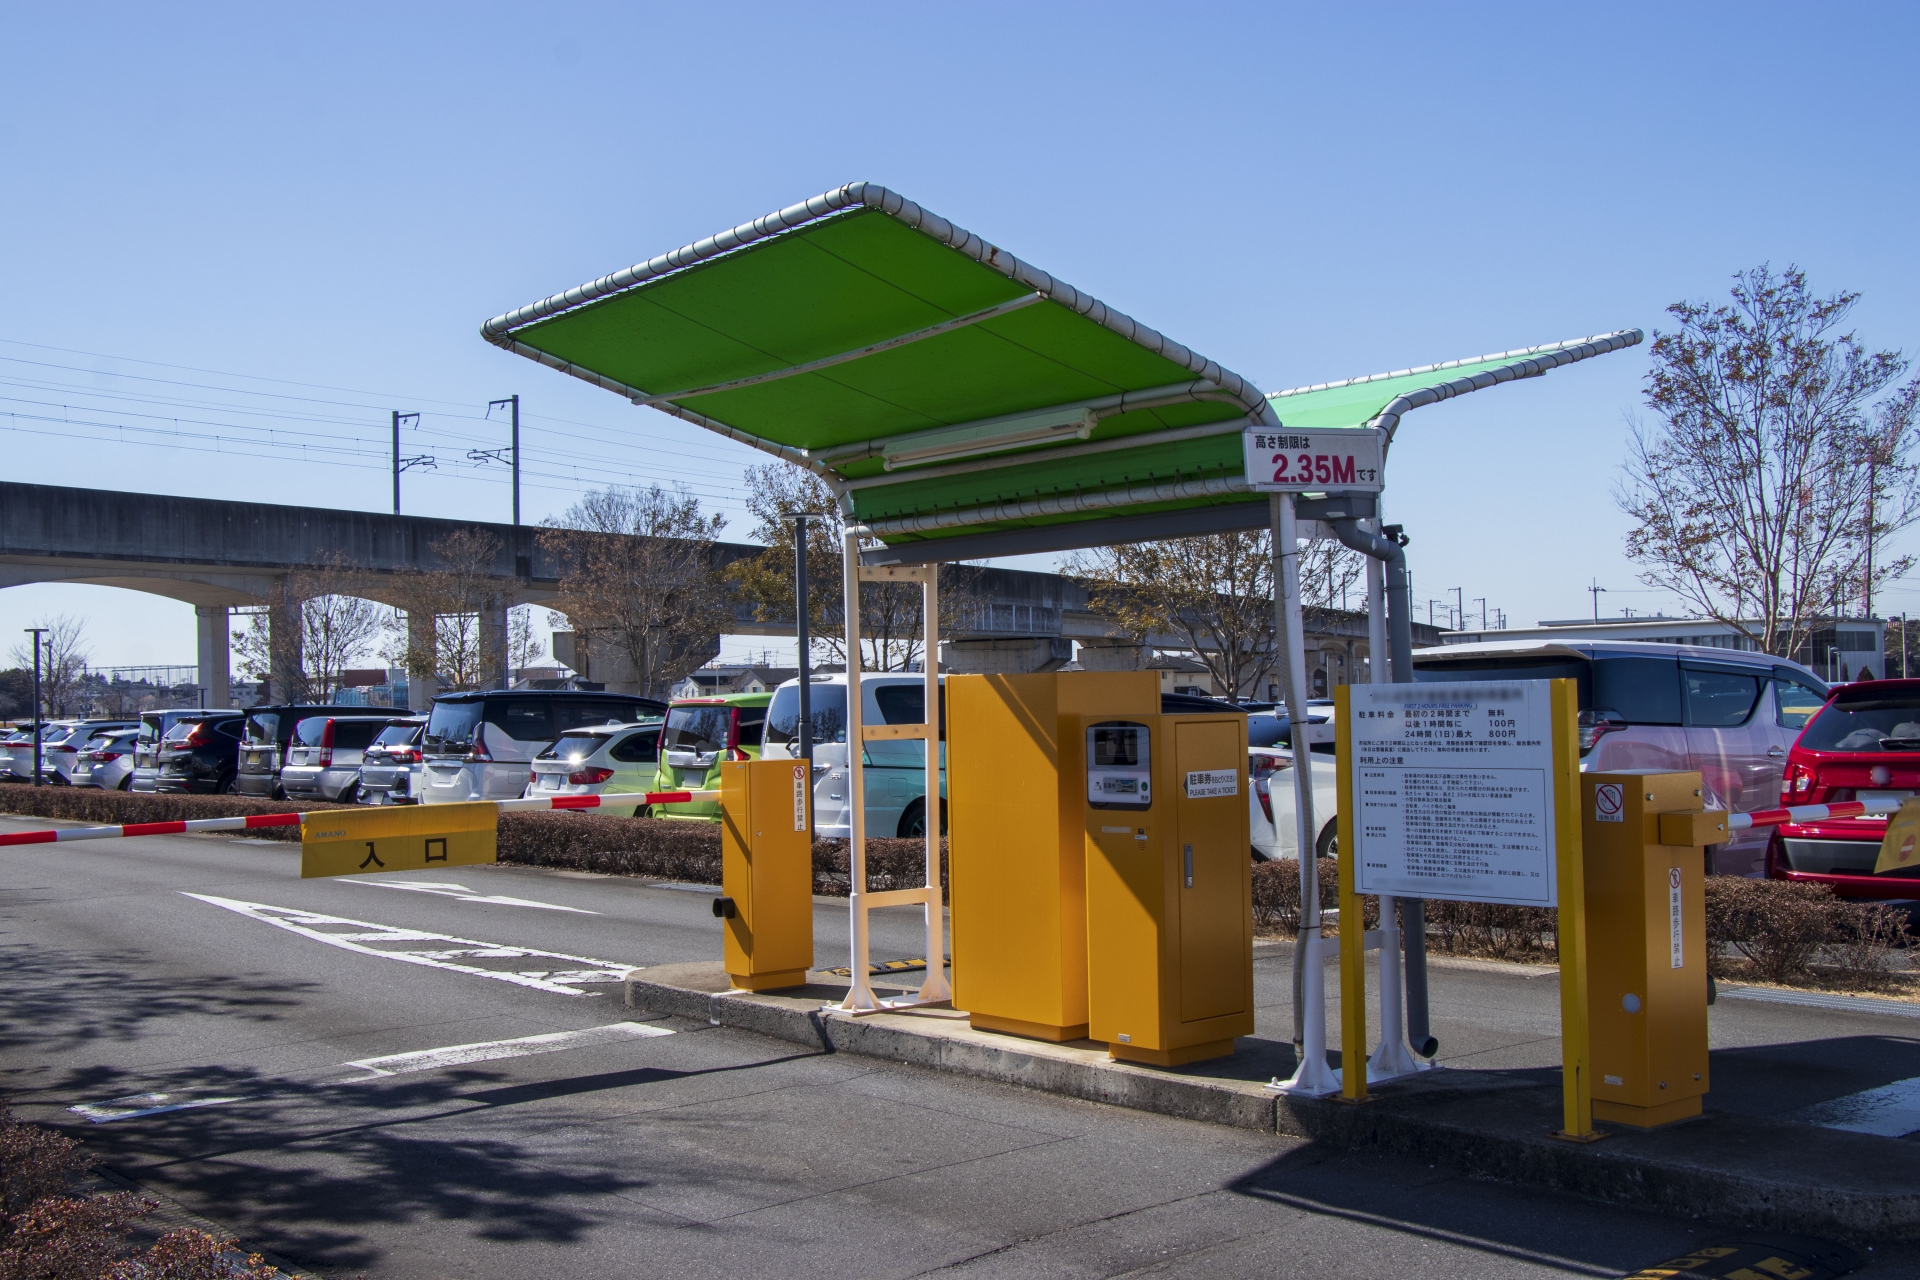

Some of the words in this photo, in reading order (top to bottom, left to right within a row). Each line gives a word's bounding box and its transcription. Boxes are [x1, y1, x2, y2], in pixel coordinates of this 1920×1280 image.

[1255, 435, 1310, 449] 高さ制限は
[1271, 453, 1356, 484] 2.35M
[1356, 468, 1376, 482] です
[1359, 711, 1395, 719] 駐車料金
[1405, 710, 1470, 718] 最初の2時間まで
[1488, 709, 1505, 717] 無料
[1405, 720, 1461, 728] 以後1時間毎に
[1489, 719, 1515, 728] 100円
[1489, 730, 1516, 738] 800円
[1360, 756, 1404, 765] 利用上の注意
[1190, 788, 1206, 796] PLEASE
[1207, 787, 1217, 795] TAKE
[1222, 786, 1236, 794] TICKET
[796, 781, 804, 831] 車路歩行禁止
[314, 830, 346, 839] AMANO
[1672, 892, 1682, 967] 車路歩行禁止
